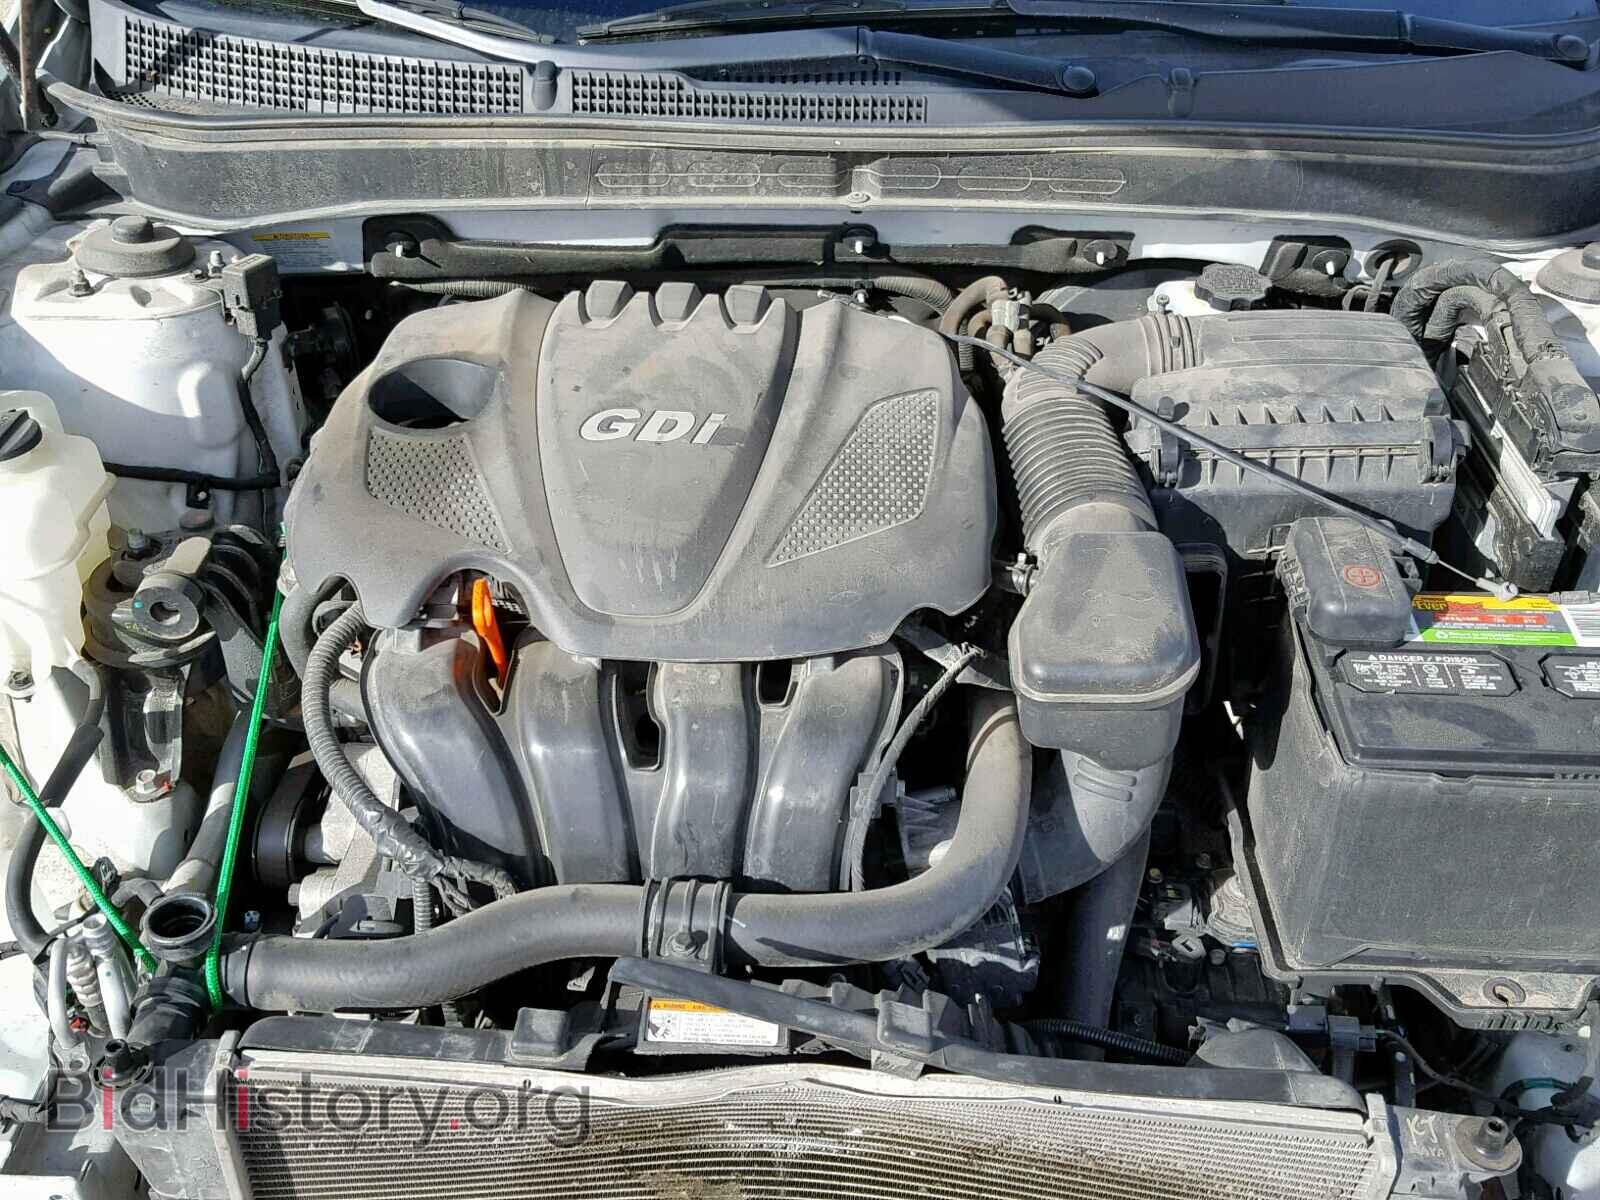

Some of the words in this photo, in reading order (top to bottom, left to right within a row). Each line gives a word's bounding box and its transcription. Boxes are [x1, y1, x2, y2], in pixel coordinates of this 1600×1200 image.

[578, 408, 728, 444] GDi
[1378, 654, 1424, 662] DANGER
[1435, 655, 1478, 664] POISON
